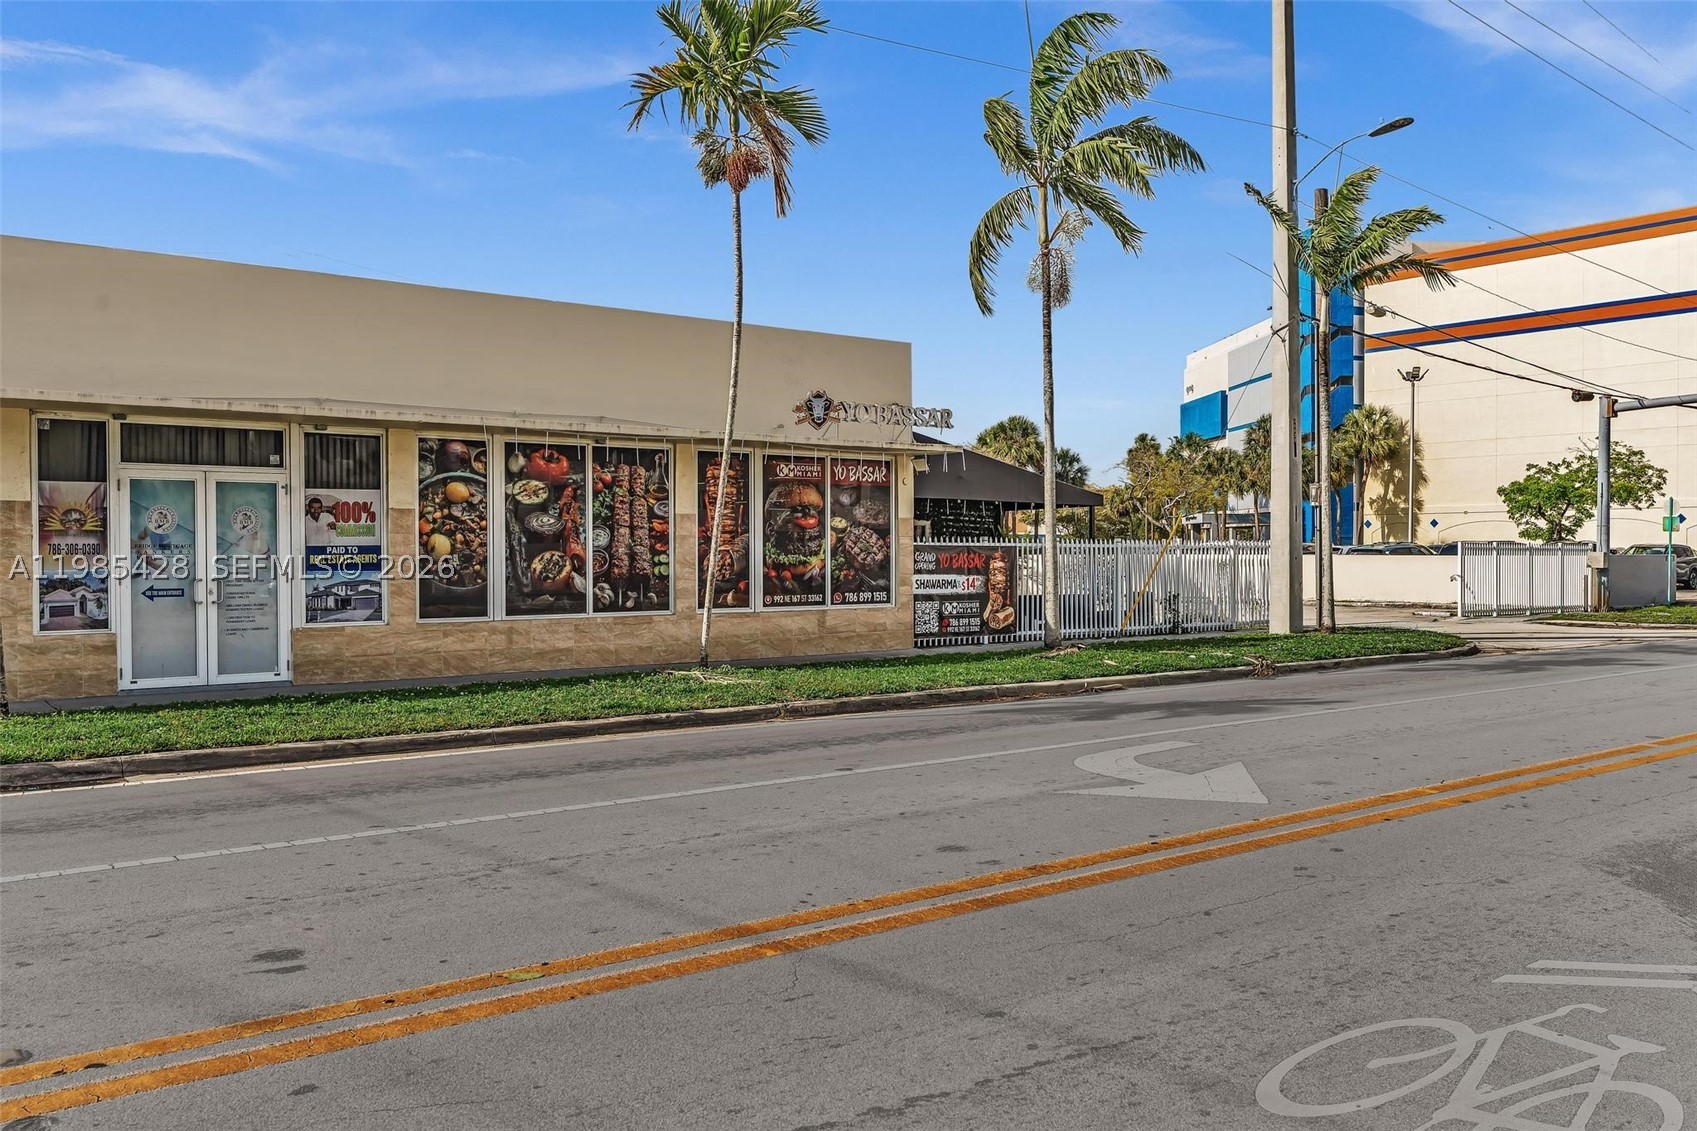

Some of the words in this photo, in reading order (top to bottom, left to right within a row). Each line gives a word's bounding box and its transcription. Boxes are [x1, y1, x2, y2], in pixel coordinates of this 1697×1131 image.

[833, 465, 847, 481] YO
[849, 465, 887, 482] BASSAR
[333, 501, 376, 523] 100%
[336, 524, 376, 537] COMMISSION
[47, 543, 101, 555] 786-306-0390
[326, 546, 346, 554] PAID
[347, 546, 358, 554] TO
[915, 551, 936, 562] GRAND
[938, 553, 951, 568] YO
[952, 552, 986, 568] BASSAR
[914, 562, 936, 570] OPENING
[915, 579, 958, 589] SHAWARMA
[773, 595, 784, 603] 992
[784, 595, 791, 603] NE
[801, 594, 807, 602] ST
[808, 594, 823, 602] 33162
[845, 592, 858, 602] 786
[860, 592, 872, 602] 899
[873, 591, 887, 601] 1515
[949, 618, 958, 626] 786
[959, 618, 969, 626] 899
[970, 618, 980, 626] 1515
